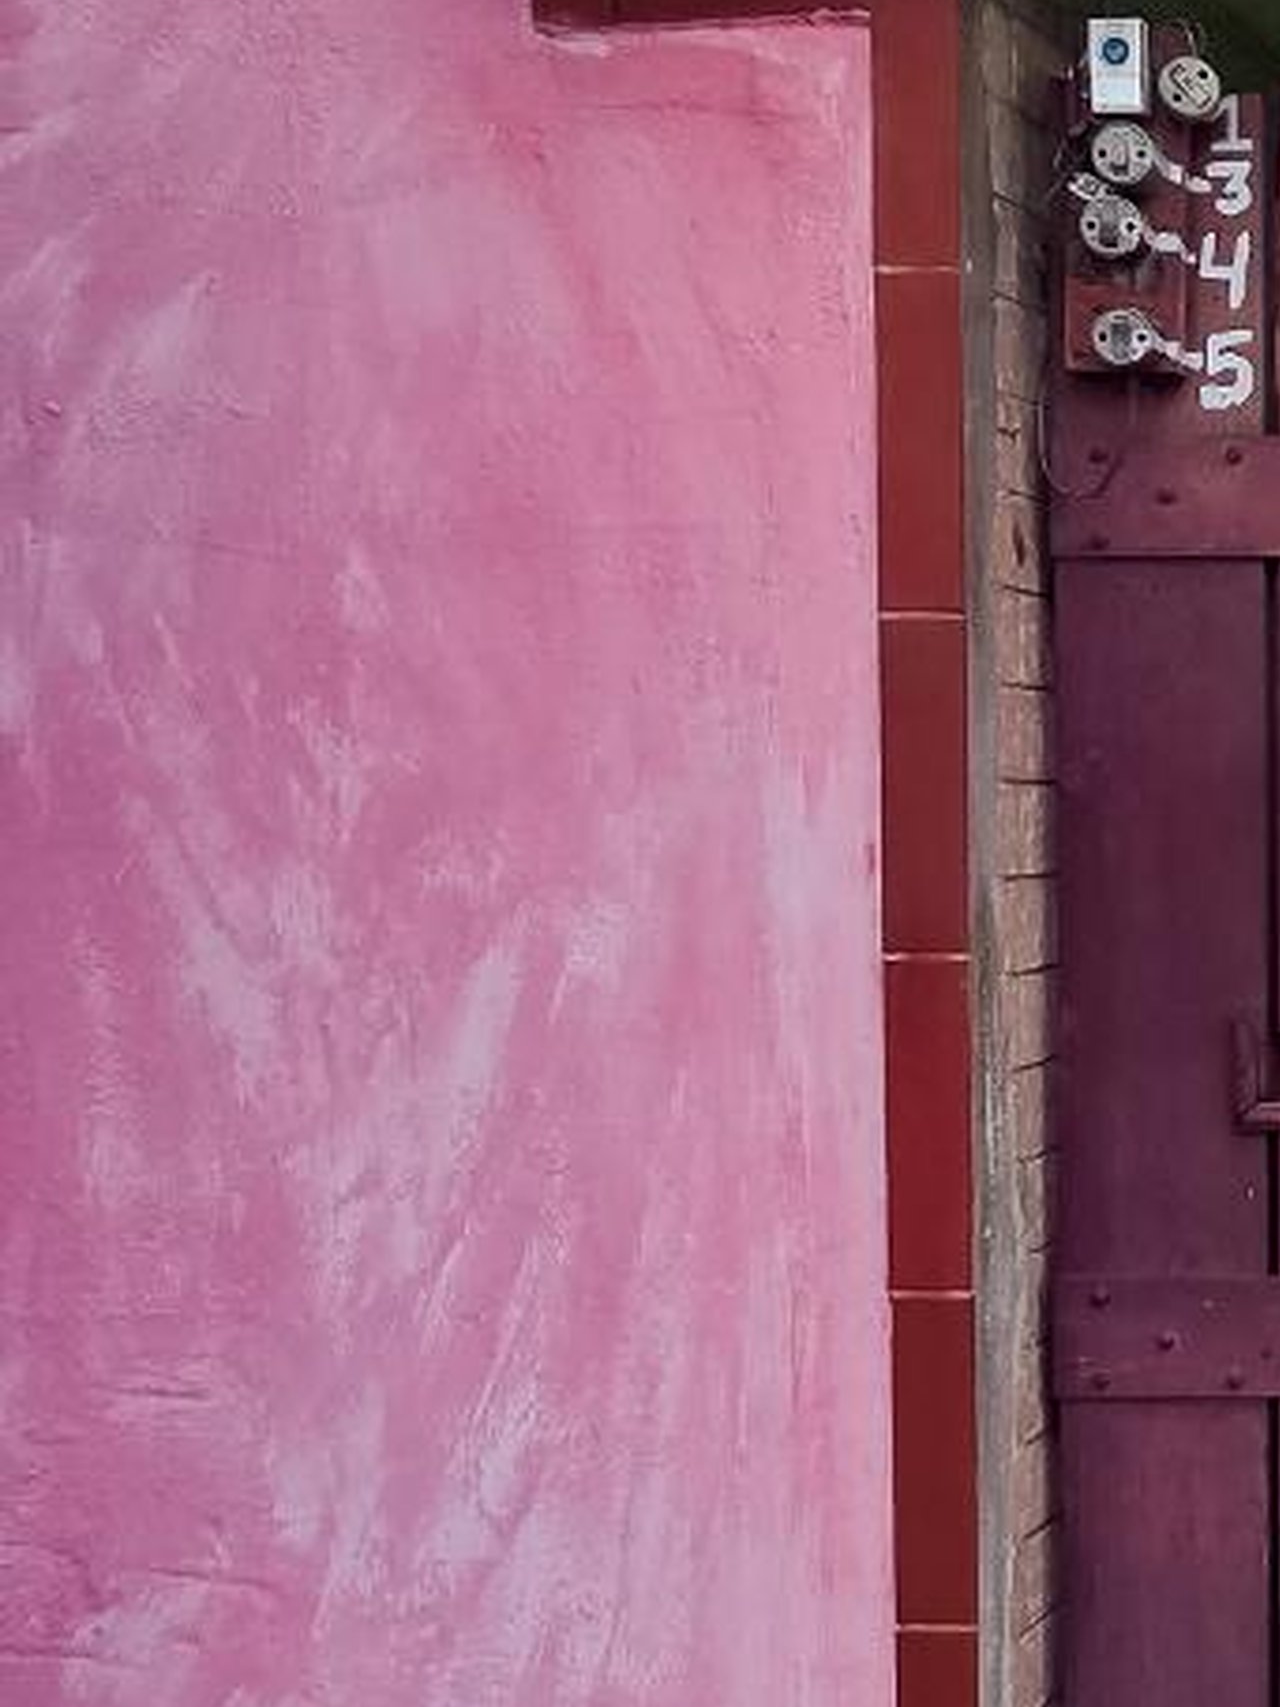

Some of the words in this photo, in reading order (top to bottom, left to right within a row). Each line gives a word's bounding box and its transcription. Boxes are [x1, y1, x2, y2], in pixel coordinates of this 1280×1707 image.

[1206, 94, 1254, 152] 1
[1206, 160, 1254, 217] 3
[1199, 230, 1252, 310] 4
[1200, 328, 1255, 411] 5
